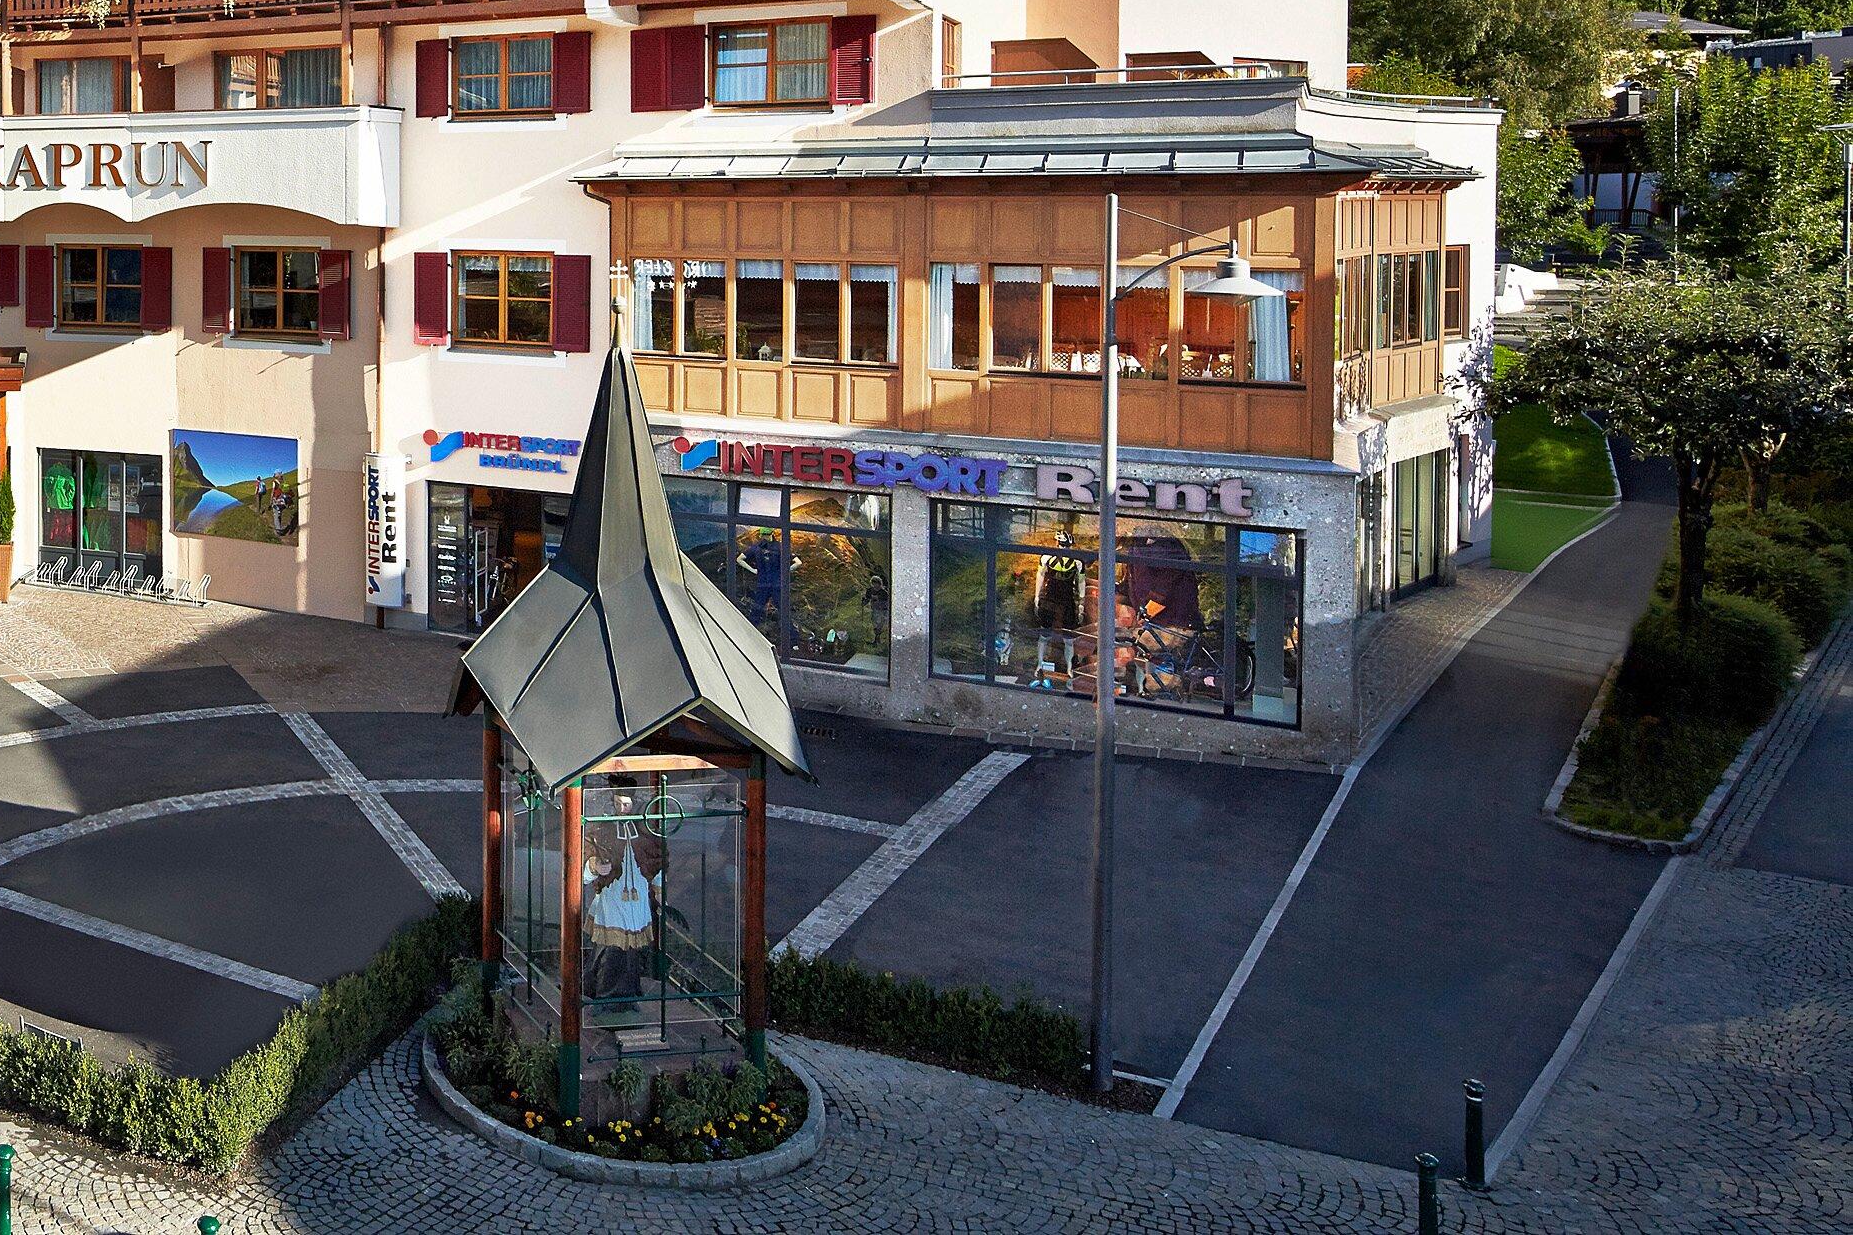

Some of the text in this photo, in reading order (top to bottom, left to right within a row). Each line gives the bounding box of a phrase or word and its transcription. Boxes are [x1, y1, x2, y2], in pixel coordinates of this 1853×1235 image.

[463, 431, 583, 457] INTERSPORT
[479, 453, 568, 475] BRÜNDL
[720, 439, 1253, 517] INTERSPORT Rent
[367, 462, 381, 576] INTERSPORT
[381, 491, 397, 564] Rent
